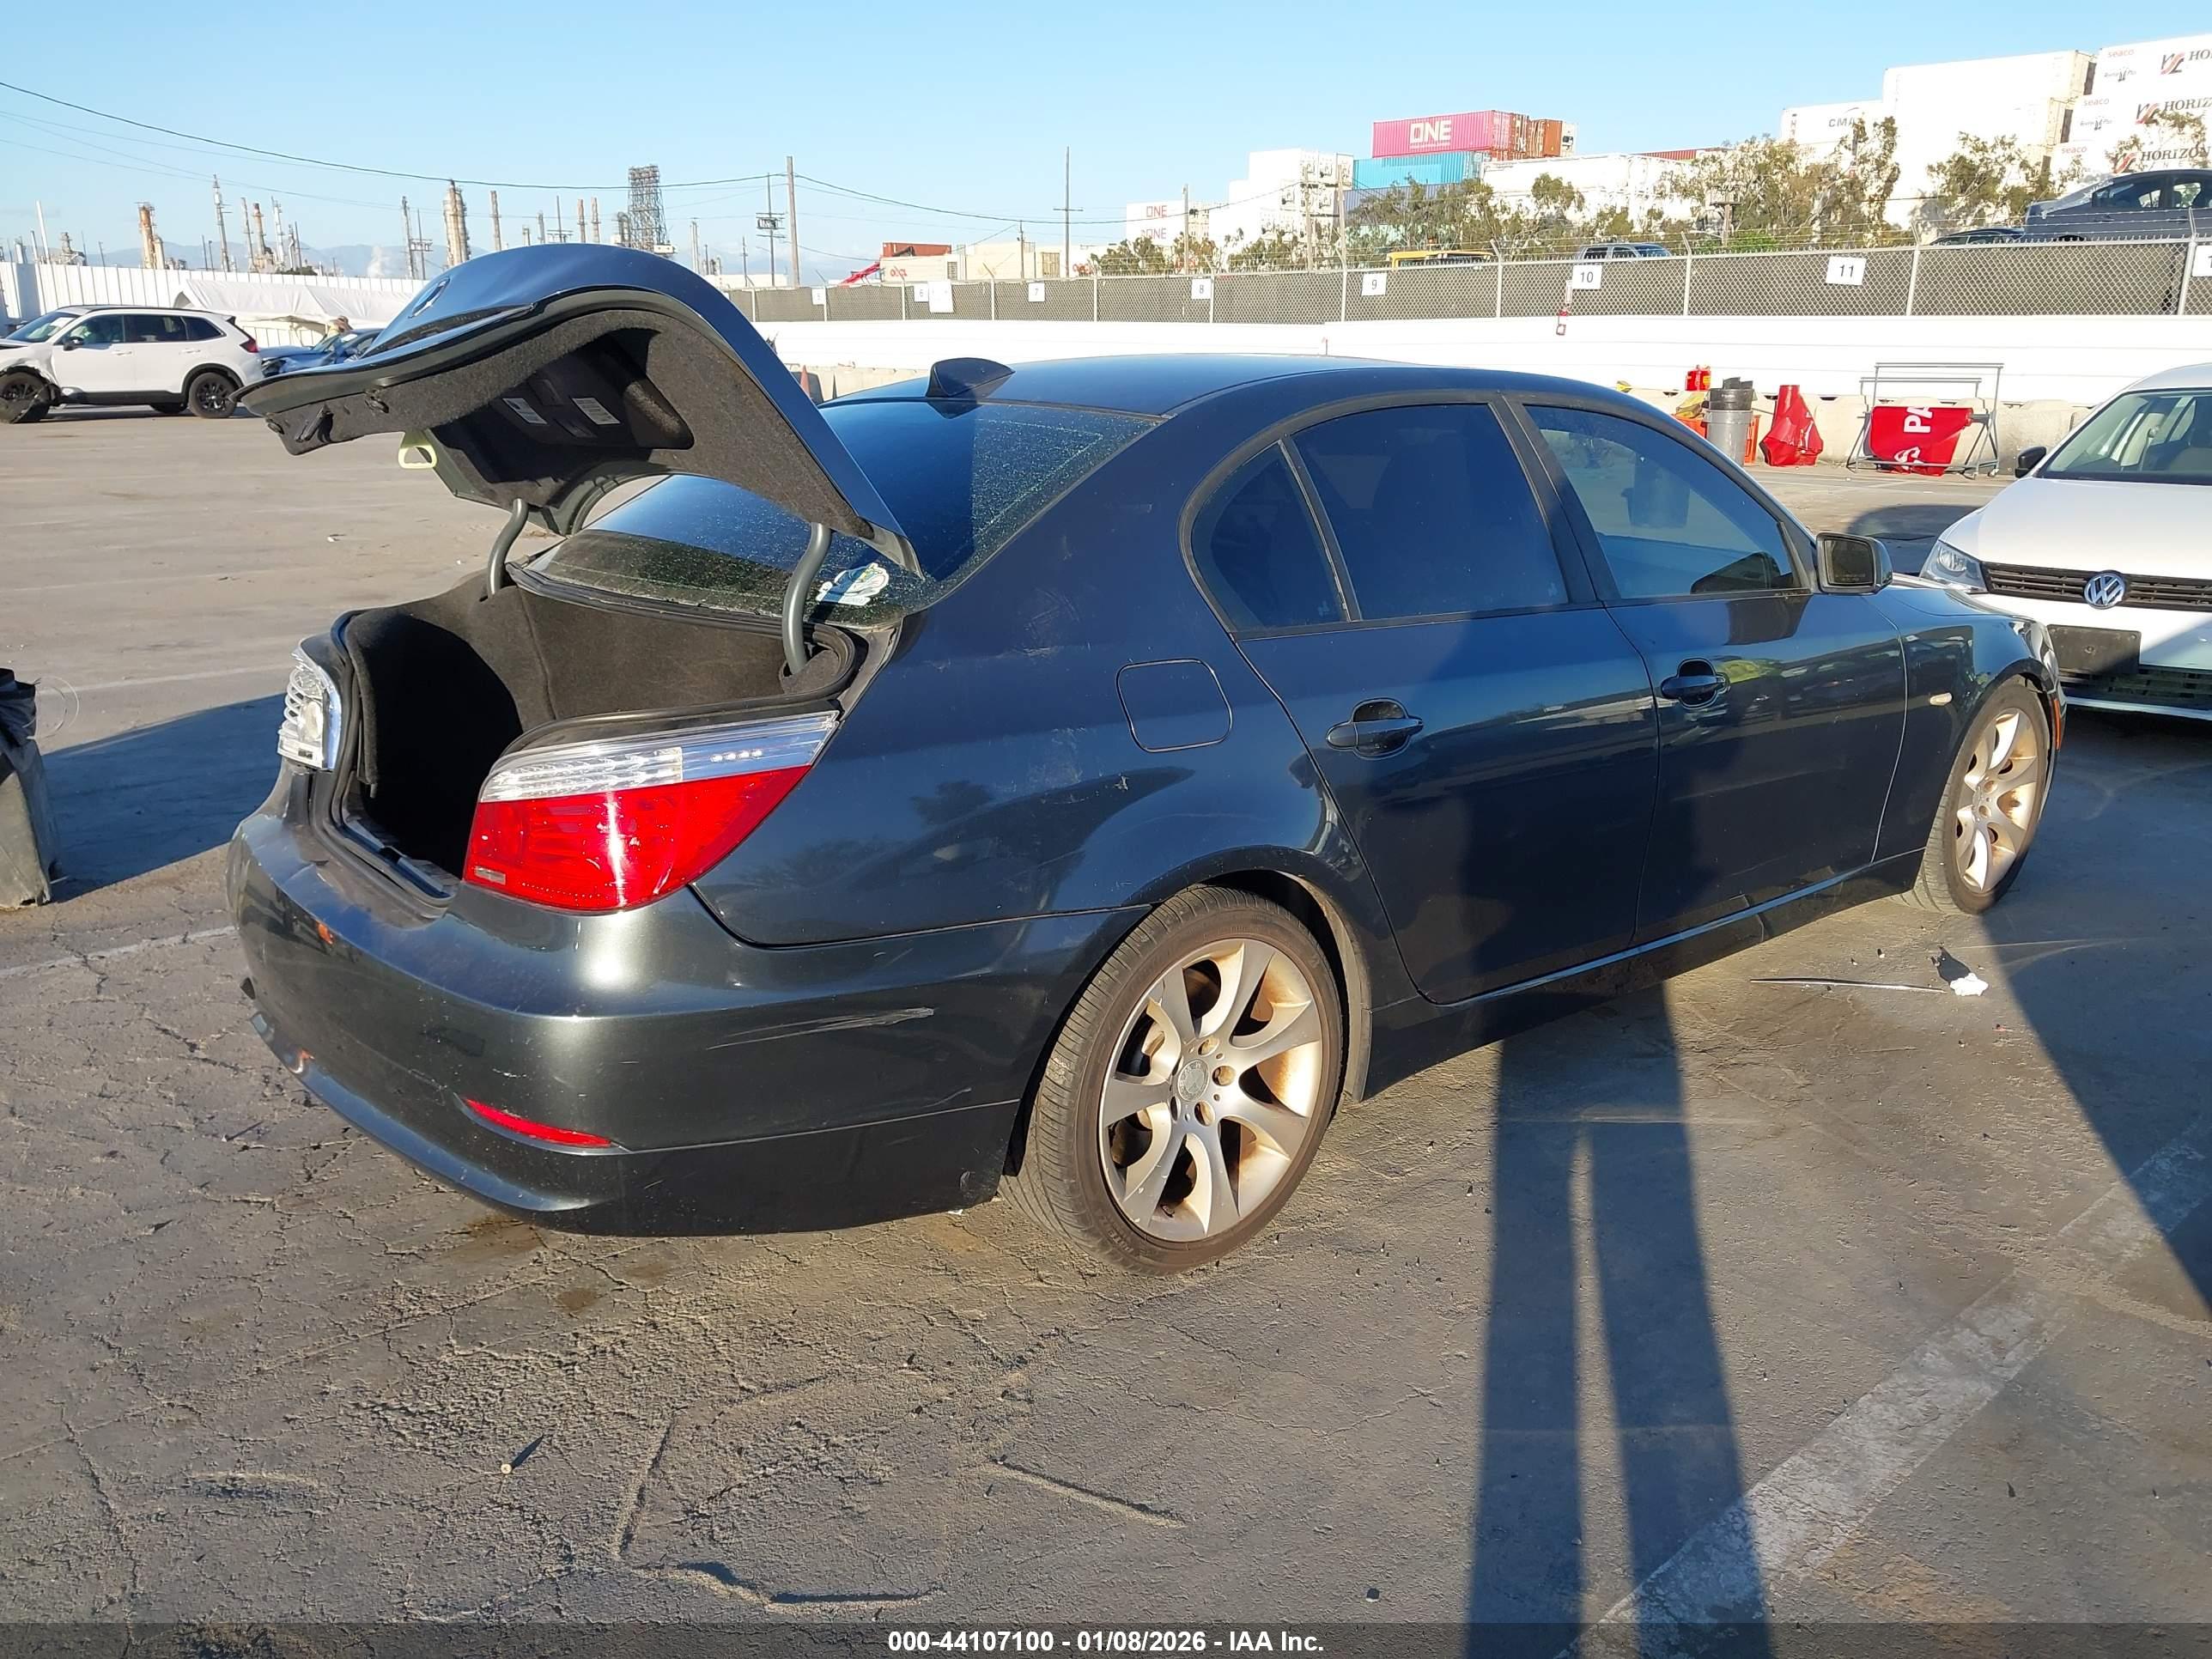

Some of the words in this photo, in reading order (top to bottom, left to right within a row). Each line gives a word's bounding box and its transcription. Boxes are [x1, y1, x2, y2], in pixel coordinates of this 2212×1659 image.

[2106, 49, 2135, 58] seaco
[2189, 48, 2212, 61] HO
[2083, 98, 2110, 106] seaco
[1409, 120, 1452, 143] ONE
[2061, 146, 2087, 155] seaco
[1146, 205, 1168, 218] ONE
[1839, 264, 1854, 277] 11
[1581, 271, 1594, 283] 10
[1199, 284, 1205, 295] 8
[1371, 279, 1377, 290] 9
[1034, 288, 1040, 296] 7
